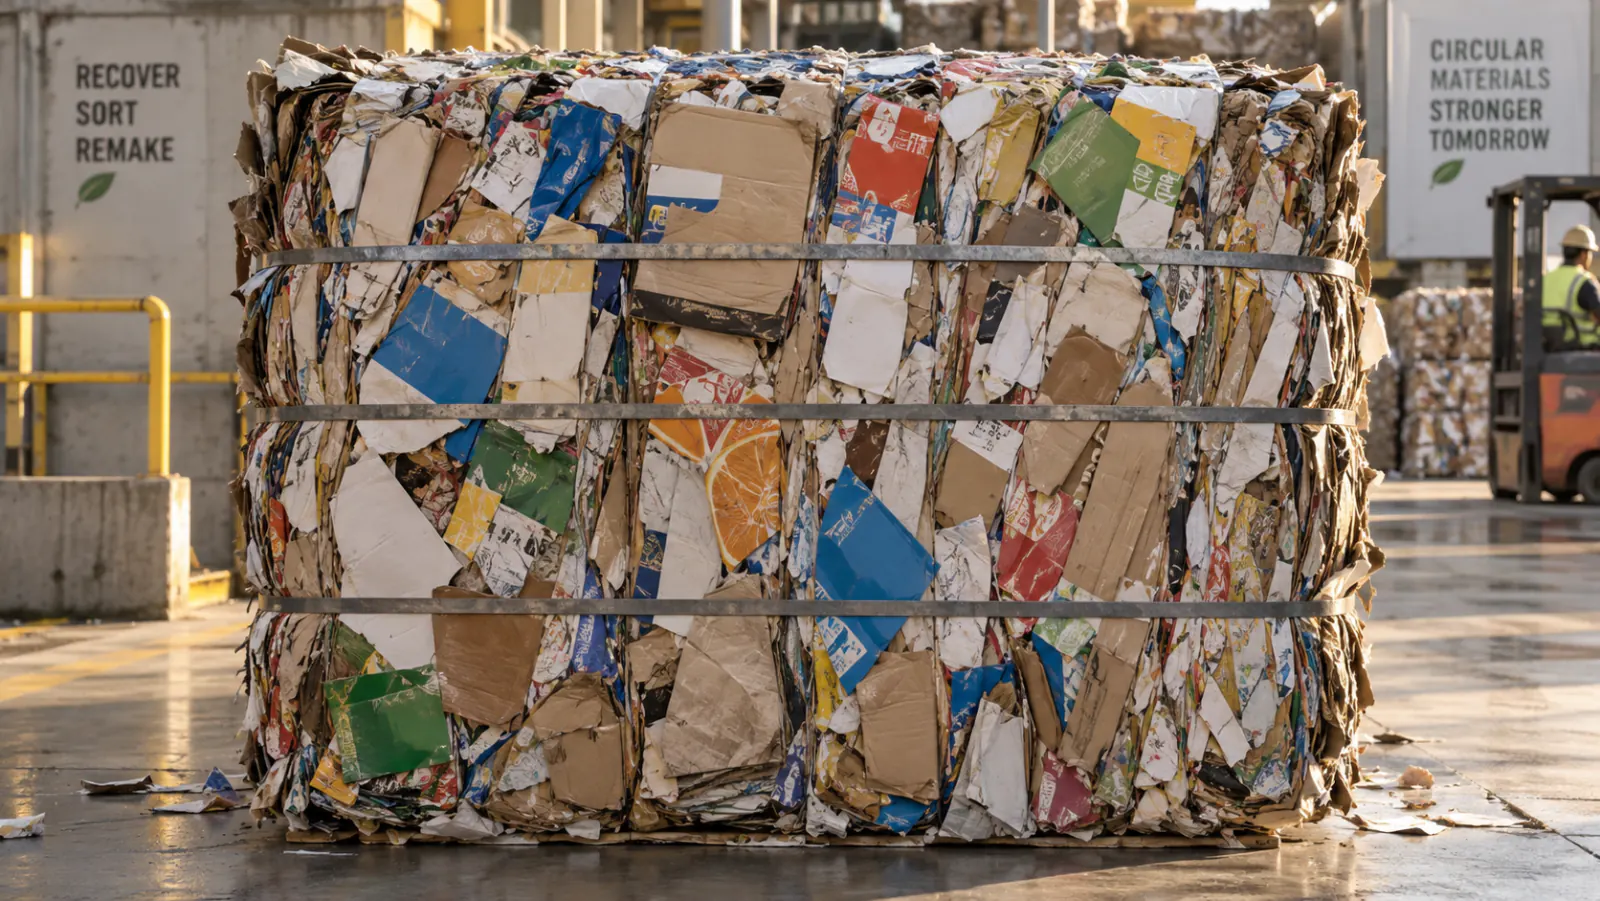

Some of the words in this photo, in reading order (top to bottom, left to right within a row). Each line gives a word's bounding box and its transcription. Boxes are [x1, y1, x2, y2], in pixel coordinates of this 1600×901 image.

[1430, 38, 1544, 62] CIRCULAR
[76, 63, 180, 89] RECOVER
[1430, 67, 1551, 91] MATERIALS
[75, 99, 138, 126] SORT
[1429, 98, 1542, 122] STRONGER
[76, 136, 174, 163] REMAKE
[1429, 128, 1551, 151] TOMORROW
